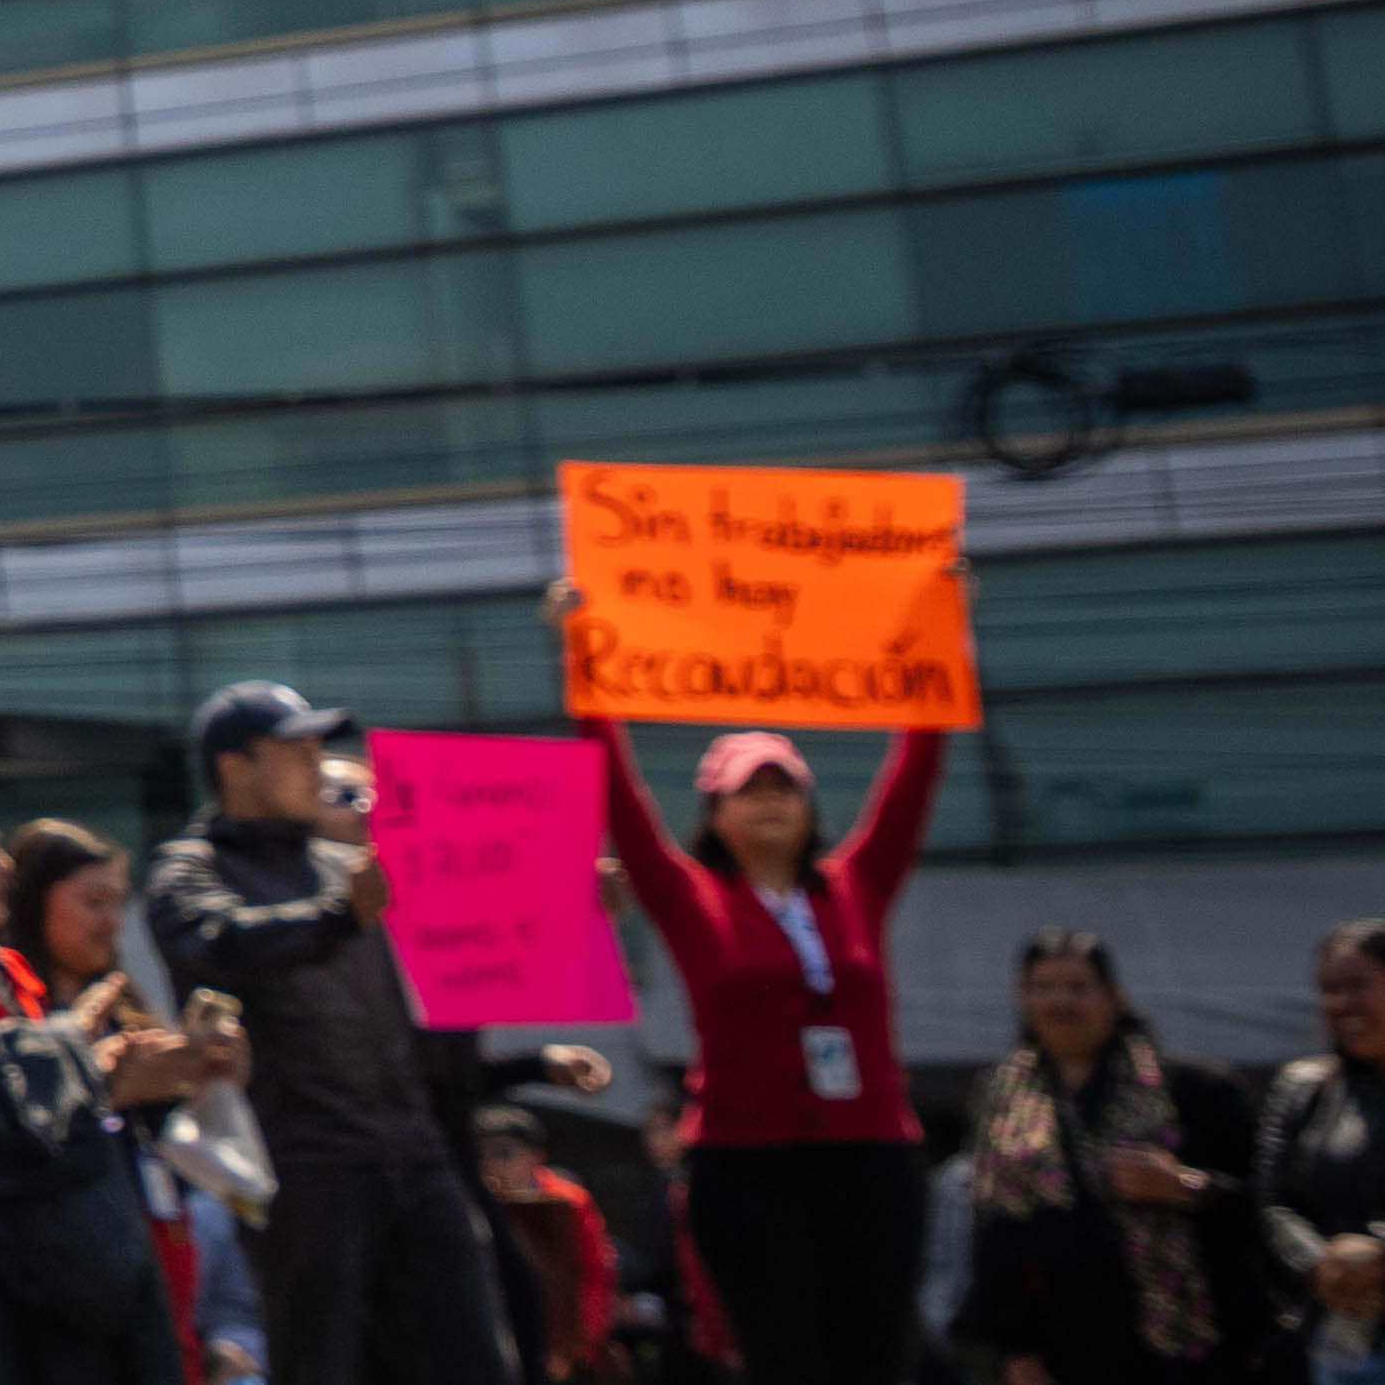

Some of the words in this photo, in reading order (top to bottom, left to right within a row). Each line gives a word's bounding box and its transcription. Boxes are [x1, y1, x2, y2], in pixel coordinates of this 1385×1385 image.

[582, 468, 692, 549] Sin
[618, 566, 692, 608] no
[709, 556, 798, 630] hay
[568, 617, 956, 711] Recaudación
